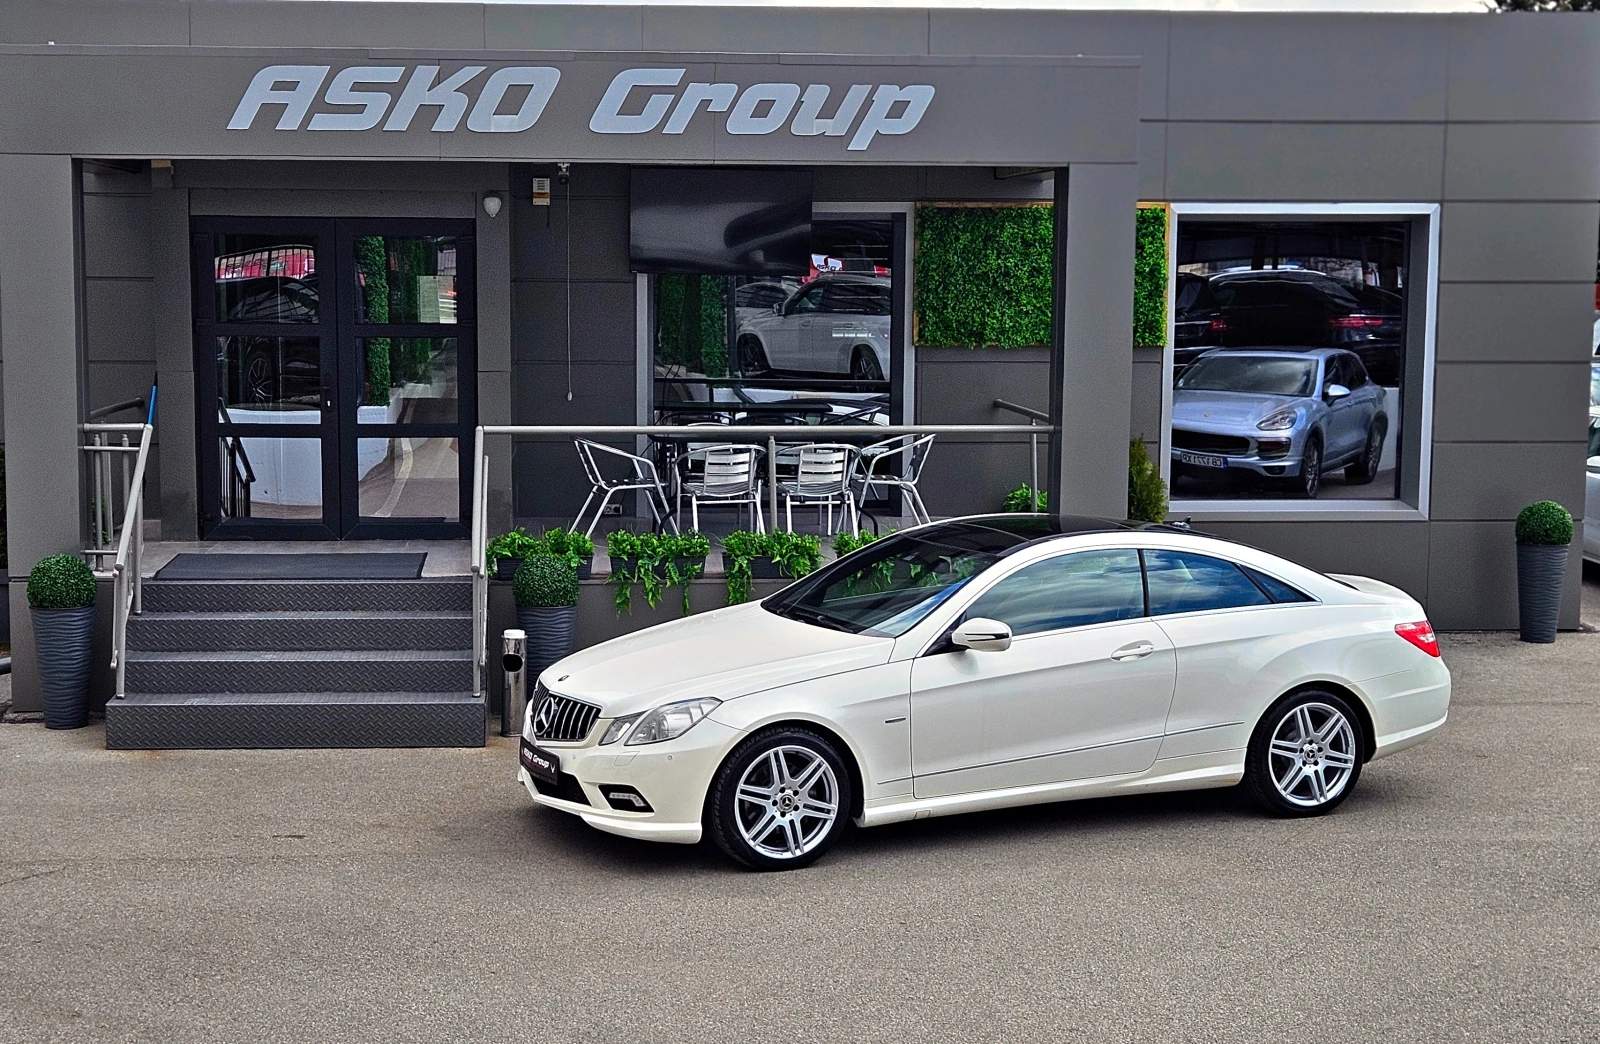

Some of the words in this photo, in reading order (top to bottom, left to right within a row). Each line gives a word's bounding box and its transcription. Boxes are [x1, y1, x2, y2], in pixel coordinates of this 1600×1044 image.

[226, 65, 562, 133] ASKO
[589, 68, 936, 151] Group
[533, 754, 549, 768] Group
